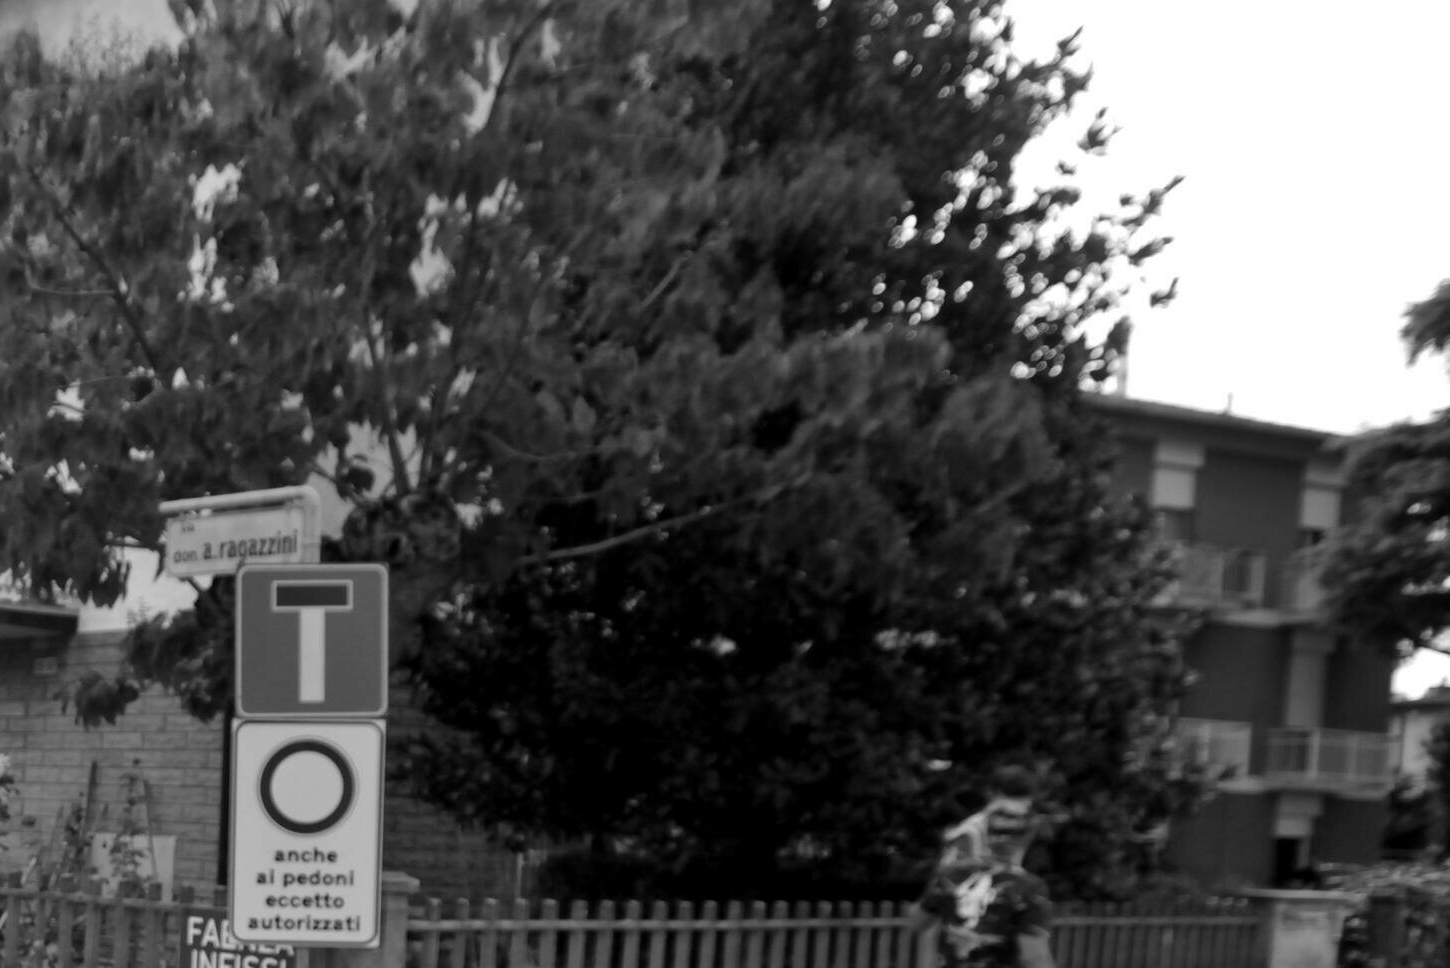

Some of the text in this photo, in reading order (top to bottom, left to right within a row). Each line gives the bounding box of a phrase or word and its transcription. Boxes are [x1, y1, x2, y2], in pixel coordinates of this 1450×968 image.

[274, 846, 338, 863] anche
[256, 869, 355, 888] ai pedoni
[265, 892, 346, 909] eccetto
[247, 914, 361, 932] autorizzati
